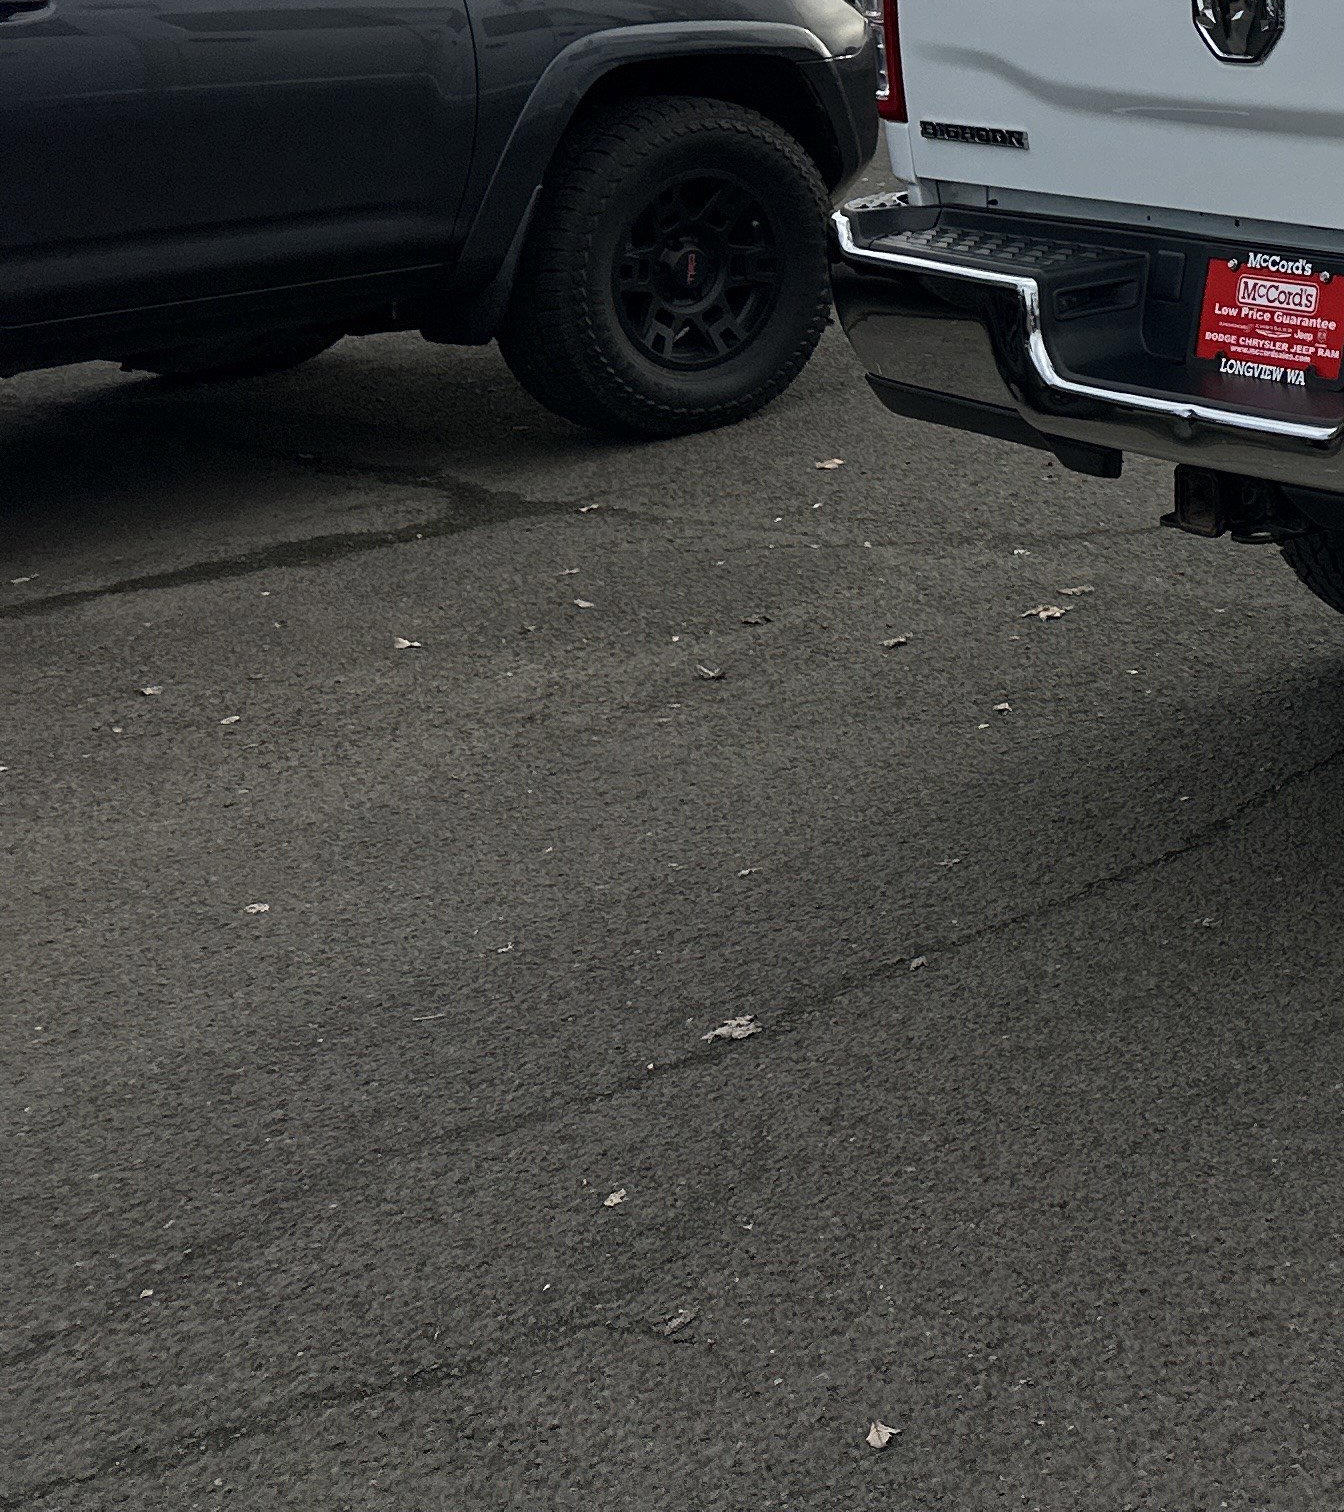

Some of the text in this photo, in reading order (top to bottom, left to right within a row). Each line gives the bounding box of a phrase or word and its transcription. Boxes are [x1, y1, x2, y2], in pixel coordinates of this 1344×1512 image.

[1247, 252, 1312, 275] McCord's
[1241, 281, 1313, 308] McCord's
[1214, 303, 1239, 317] Low
[1241, 307, 1271, 322] Price
[1274, 311, 1337, 330] Guarantee
[1205, 331, 1237, 344] DODGE
[1239, 336, 1289, 352] CHRYSLER
[1290, 344, 1315, 355] JEEP
[1317, 348, 1340, 359] RAM
[1293, 329, 1314, 342] Jeep
[1220, 358, 1306, 386] LONGVIEW WA
